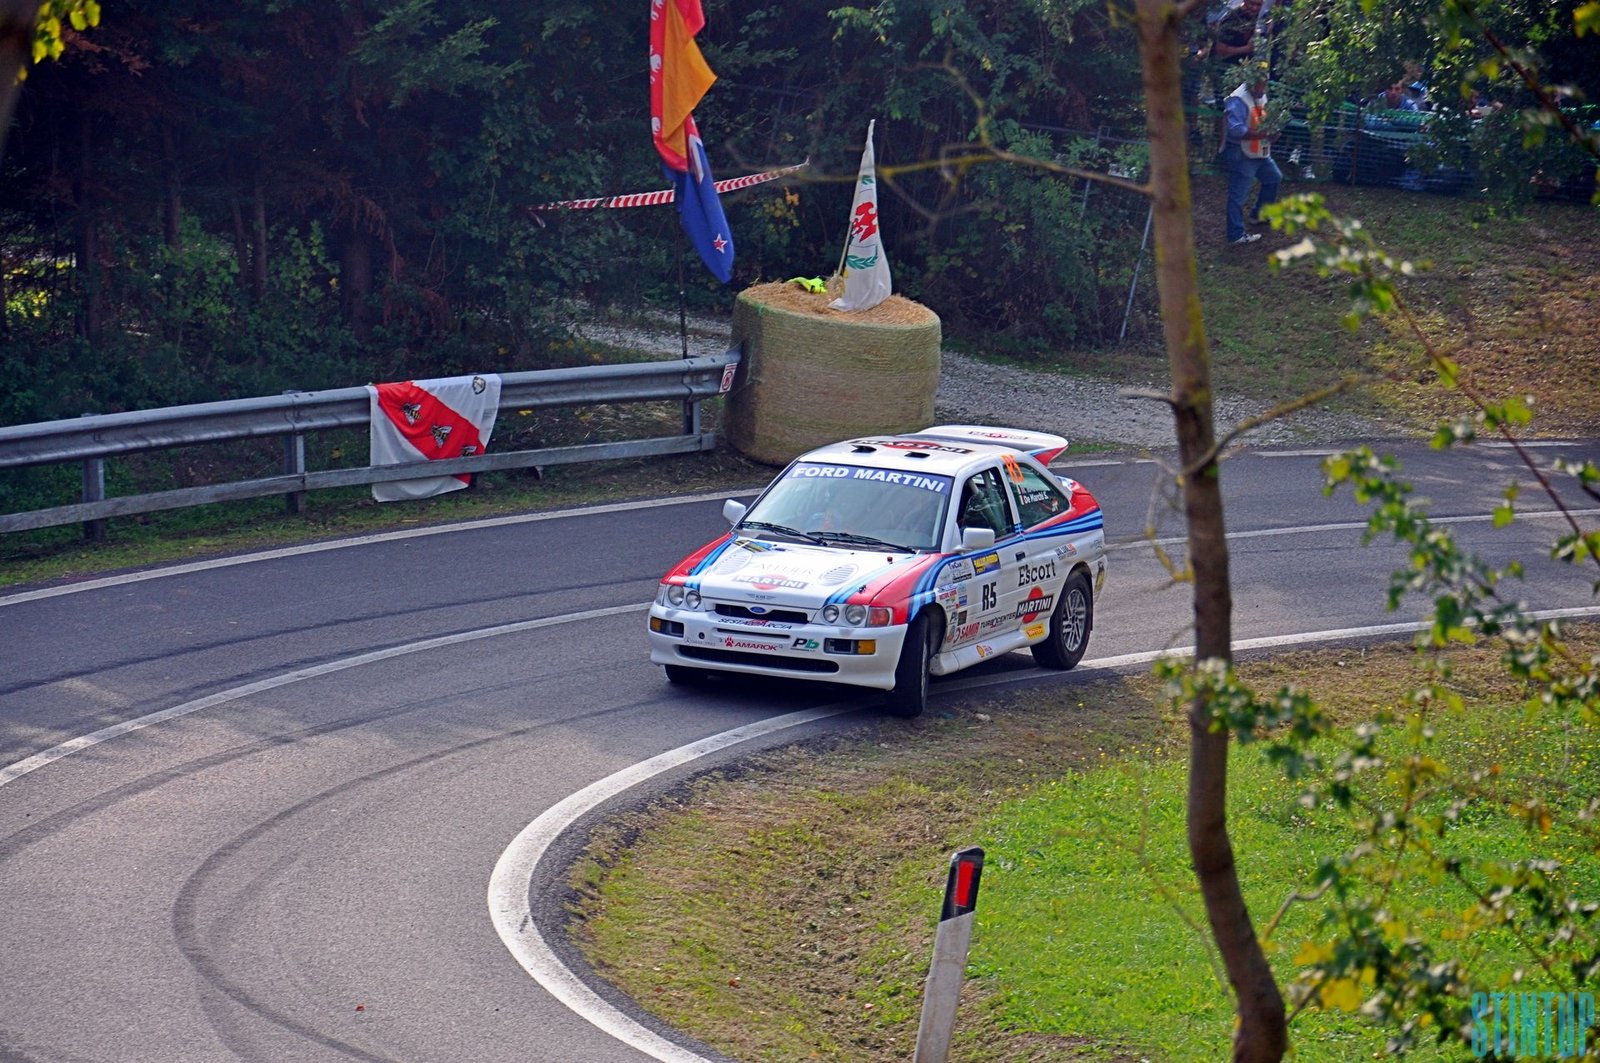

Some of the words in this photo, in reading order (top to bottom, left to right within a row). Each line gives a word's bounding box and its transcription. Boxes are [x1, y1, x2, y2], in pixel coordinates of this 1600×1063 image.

[856, 440, 967, 454] MARTINI
[791, 466, 850, 479] FORD
[853, 468, 946, 493] MARTINI
[735, 576, 804, 589] MARTINI
[1018, 559, 1056, 587] Escort
[982, 582, 997, 611] R5
[1017, 595, 1052, 617] MARTINI
[734, 641, 779, 651] AMAROK
